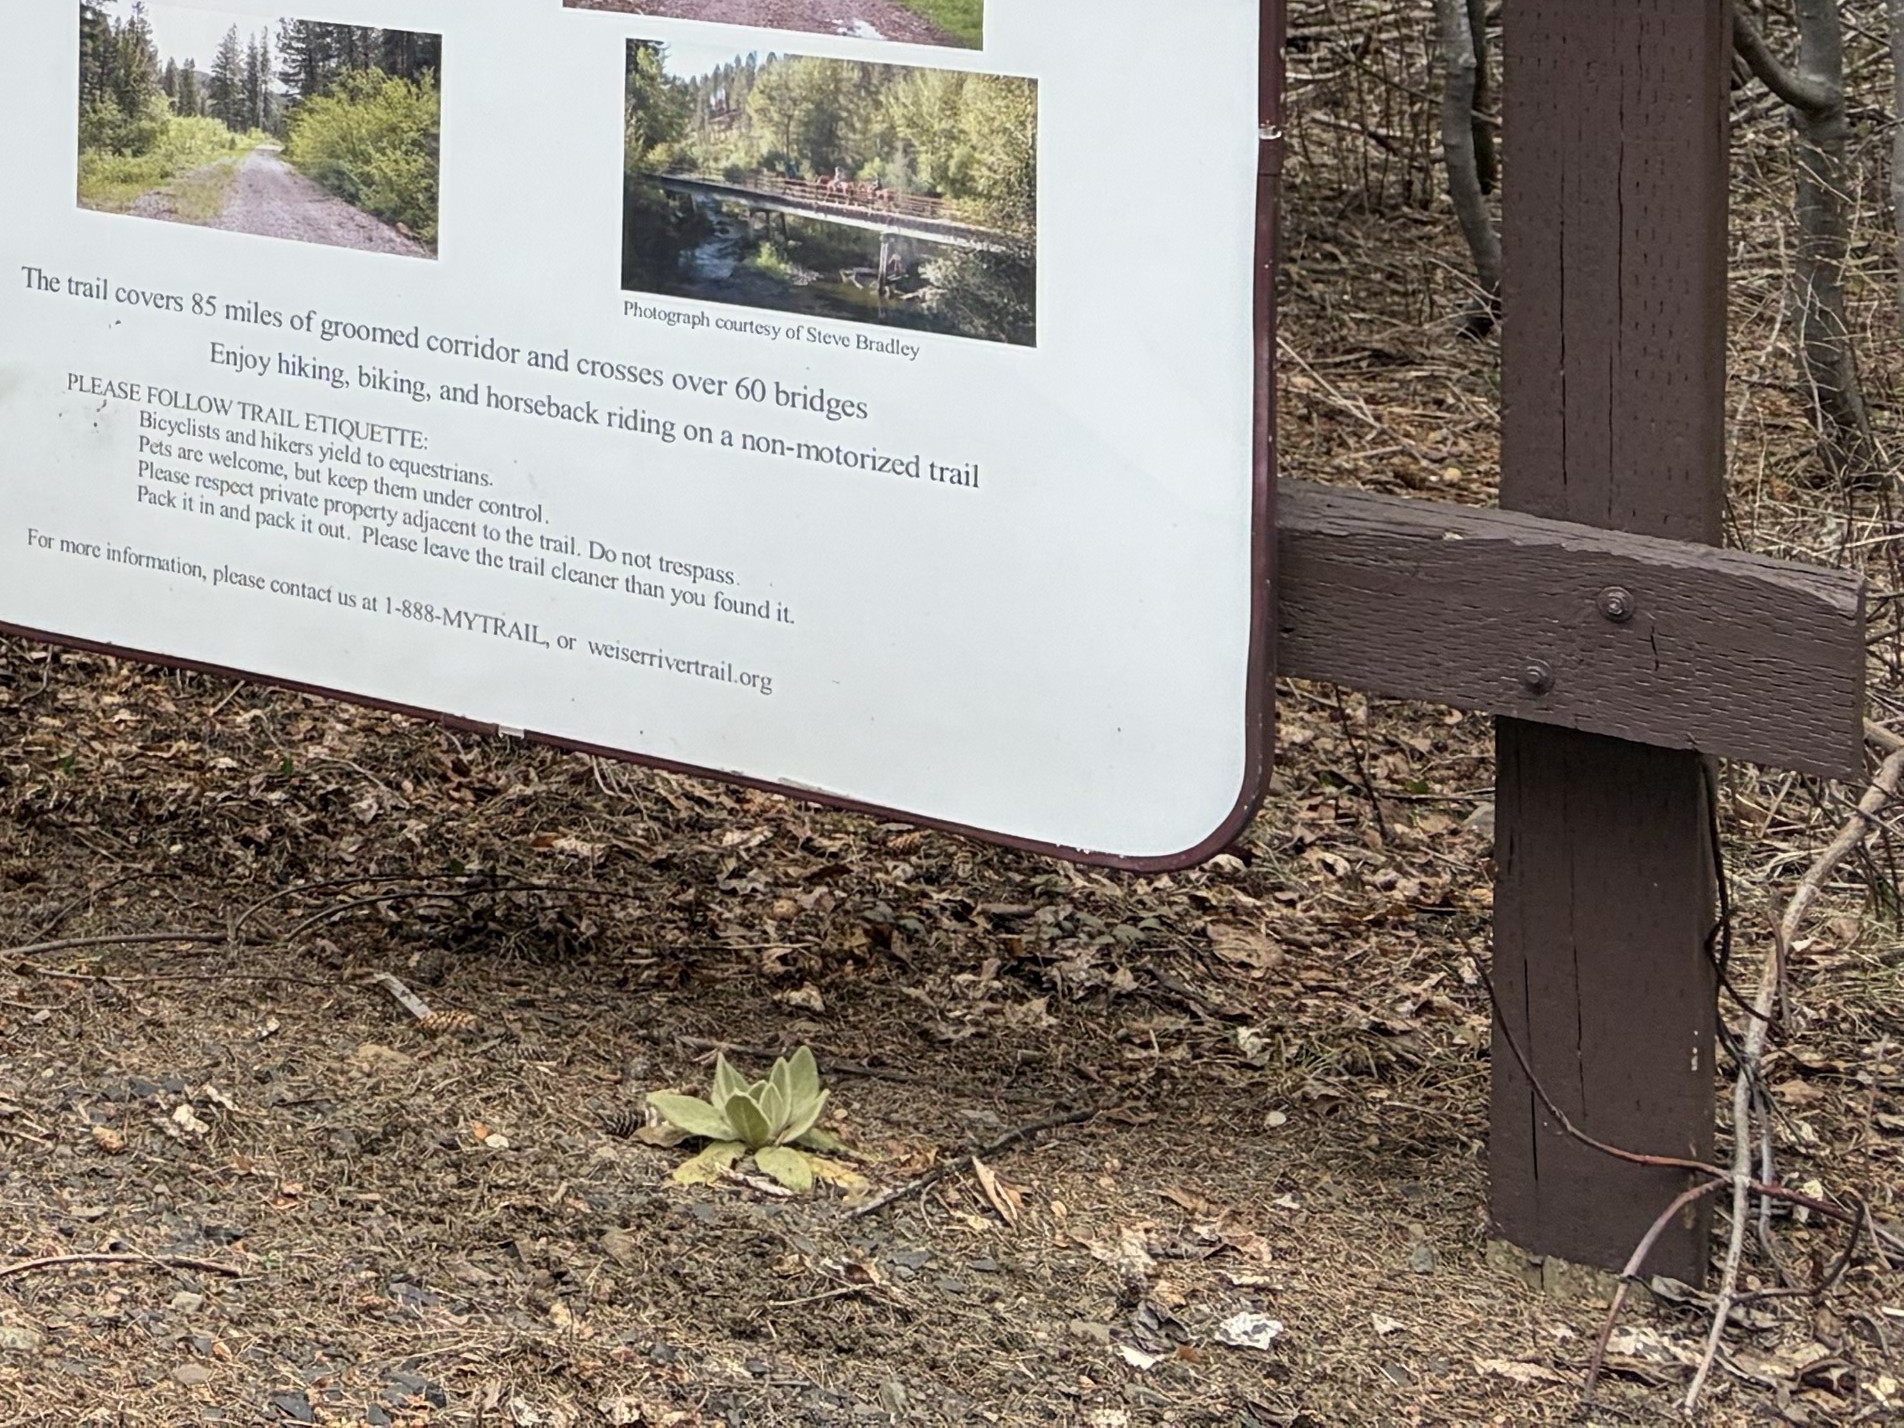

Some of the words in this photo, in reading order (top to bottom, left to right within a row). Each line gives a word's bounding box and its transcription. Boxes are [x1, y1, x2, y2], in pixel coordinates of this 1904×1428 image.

[21, 266, 60, 292] The
[68, 276, 106, 299] trail
[115, 287, 182, 311] covers
[192, 292, 216, 316] 85
[225, 300, 282, 327] miles
[290, 310, 316, 331] of
[320, 319, 418, 348] groomed
[426, 334, 520, 363] corridor
[527, 349, 568, 371] and
[576, 358, 663, 386] crosses
[672, 373, 727, 395] over
[735, 377, 765, 402] 60
[774, 381, 867, 421] bridges
[624, 300, 709, 329] Photograph
[715, 318, 780, 340] courtesy
[785, 325, 803, 339] of
[806, 327, 849, 347] Steve
[856, 334, 919, 361] Bradley
[68, 372, 140, 402] PLEASE
[147, 386, 232, 415] FOLLOW
[237, 401, 299, 427] TRAIL
[305, 412, 427, 449] ETIQUETTE:
[139, 410, 219, 440] Bicyclists
[226, 428, 255, 446] and
[261, 430, 312, 455] hikers
[318, 442, 360, 464] yield
[367, 452, 383, 467] to
[389, 458, 492, 486] equestrians.
[210, 342, 270, 376] Enjoy
[278, 352, 349, 388] hiking,
[358, 364, 430, 401] biking,
[440, 383, 478, 404] and
[486, 385, 598, 424] horseback
[607, 406, 675, 442] riding
[683, 424, 712, 443] on
[720, 430, 732, 446] a
[742, 433, 919, 477] non-motorized
[929, 461, 978, 487] trail
[28, 528, 54, 548] For
[60, 539, 100, 557] more
[107, 542, 206, 581] information,
[213, 564, 264, 589] please
[270, 579, 332, 602] contact
[338, 592, 356, 606] us
[361, 596, 377, 611] at
[386, 596, 549, 648] 1-888-MYTRAIL,
[557, 635, 576, 649] or
[588, 640, 771, 695] weiserrivertrail.org
